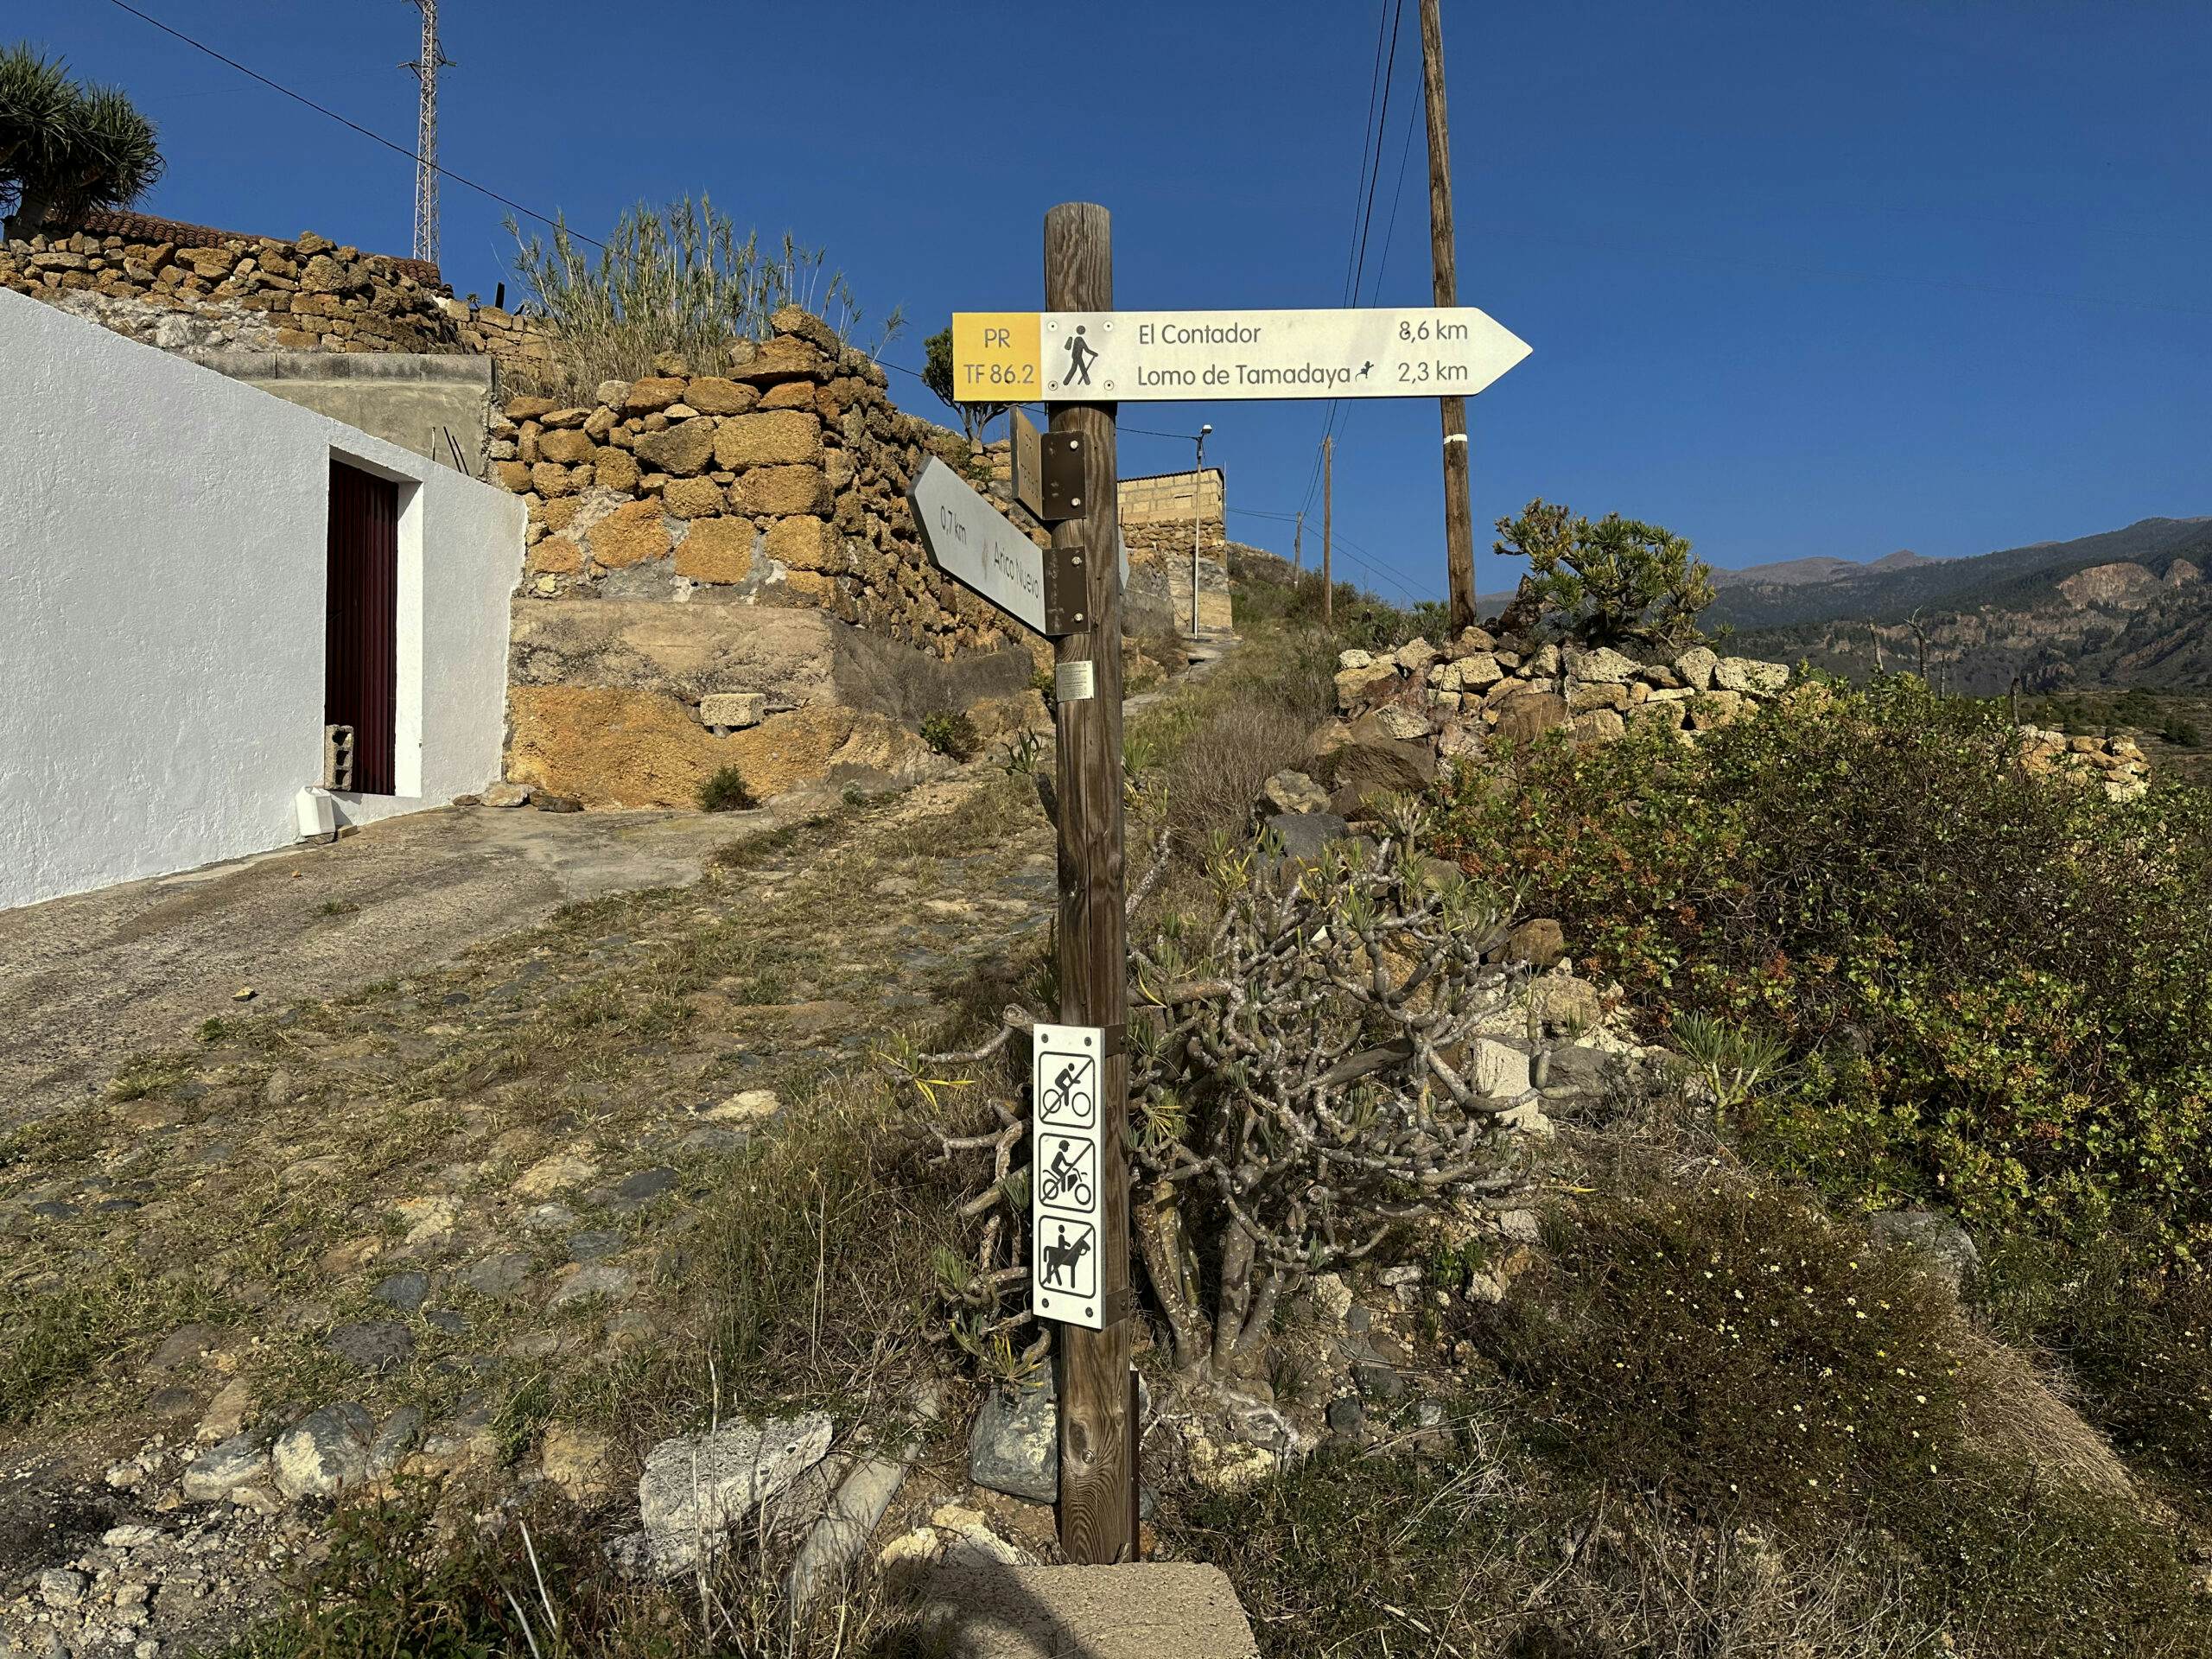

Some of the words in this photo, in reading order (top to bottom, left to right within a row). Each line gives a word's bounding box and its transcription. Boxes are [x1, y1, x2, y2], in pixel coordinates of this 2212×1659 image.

[984, 328, 1011, 348] PR
[1139, 323, 1154, 345] El
[1161, 321, 1262, 345] Contador
[1398, 320, 1430, 344] 8,6
[1436, 319, 1468, 340] km
[963, 364, 985, 384] TF
[989, 364, 1034, 385] 86.2
[1138, 365, 1198, 386] Lomo
[1202, 364, 1230, 385] de
[1236, 362, 1351, 389] Tamadaya
[1397, 361, 1430, 385] 2,3
[1436, 359, 1468, 381] km
[941, 505, 952, 535] 0,7
[955, 513, 966, 544] km
[994, 541, 1014, 581] Arico
[1016, 558, 1039, 599] Nuevo
